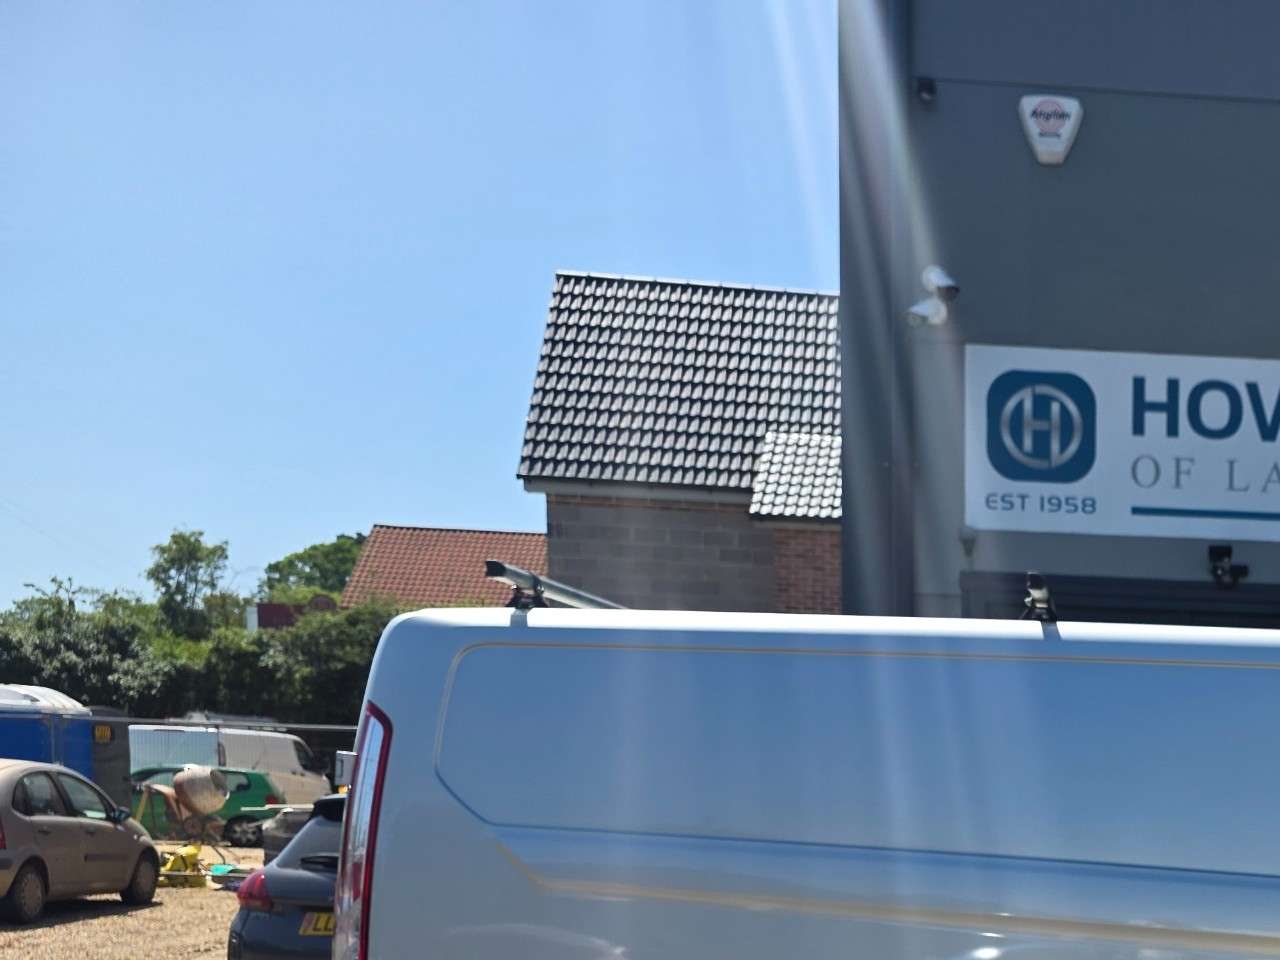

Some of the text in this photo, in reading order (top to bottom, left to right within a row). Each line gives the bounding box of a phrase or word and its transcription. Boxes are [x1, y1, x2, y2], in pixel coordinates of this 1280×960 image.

[1130, 453, 1197, 490] OF
[985, 492, 1097, 515] EST 1958
